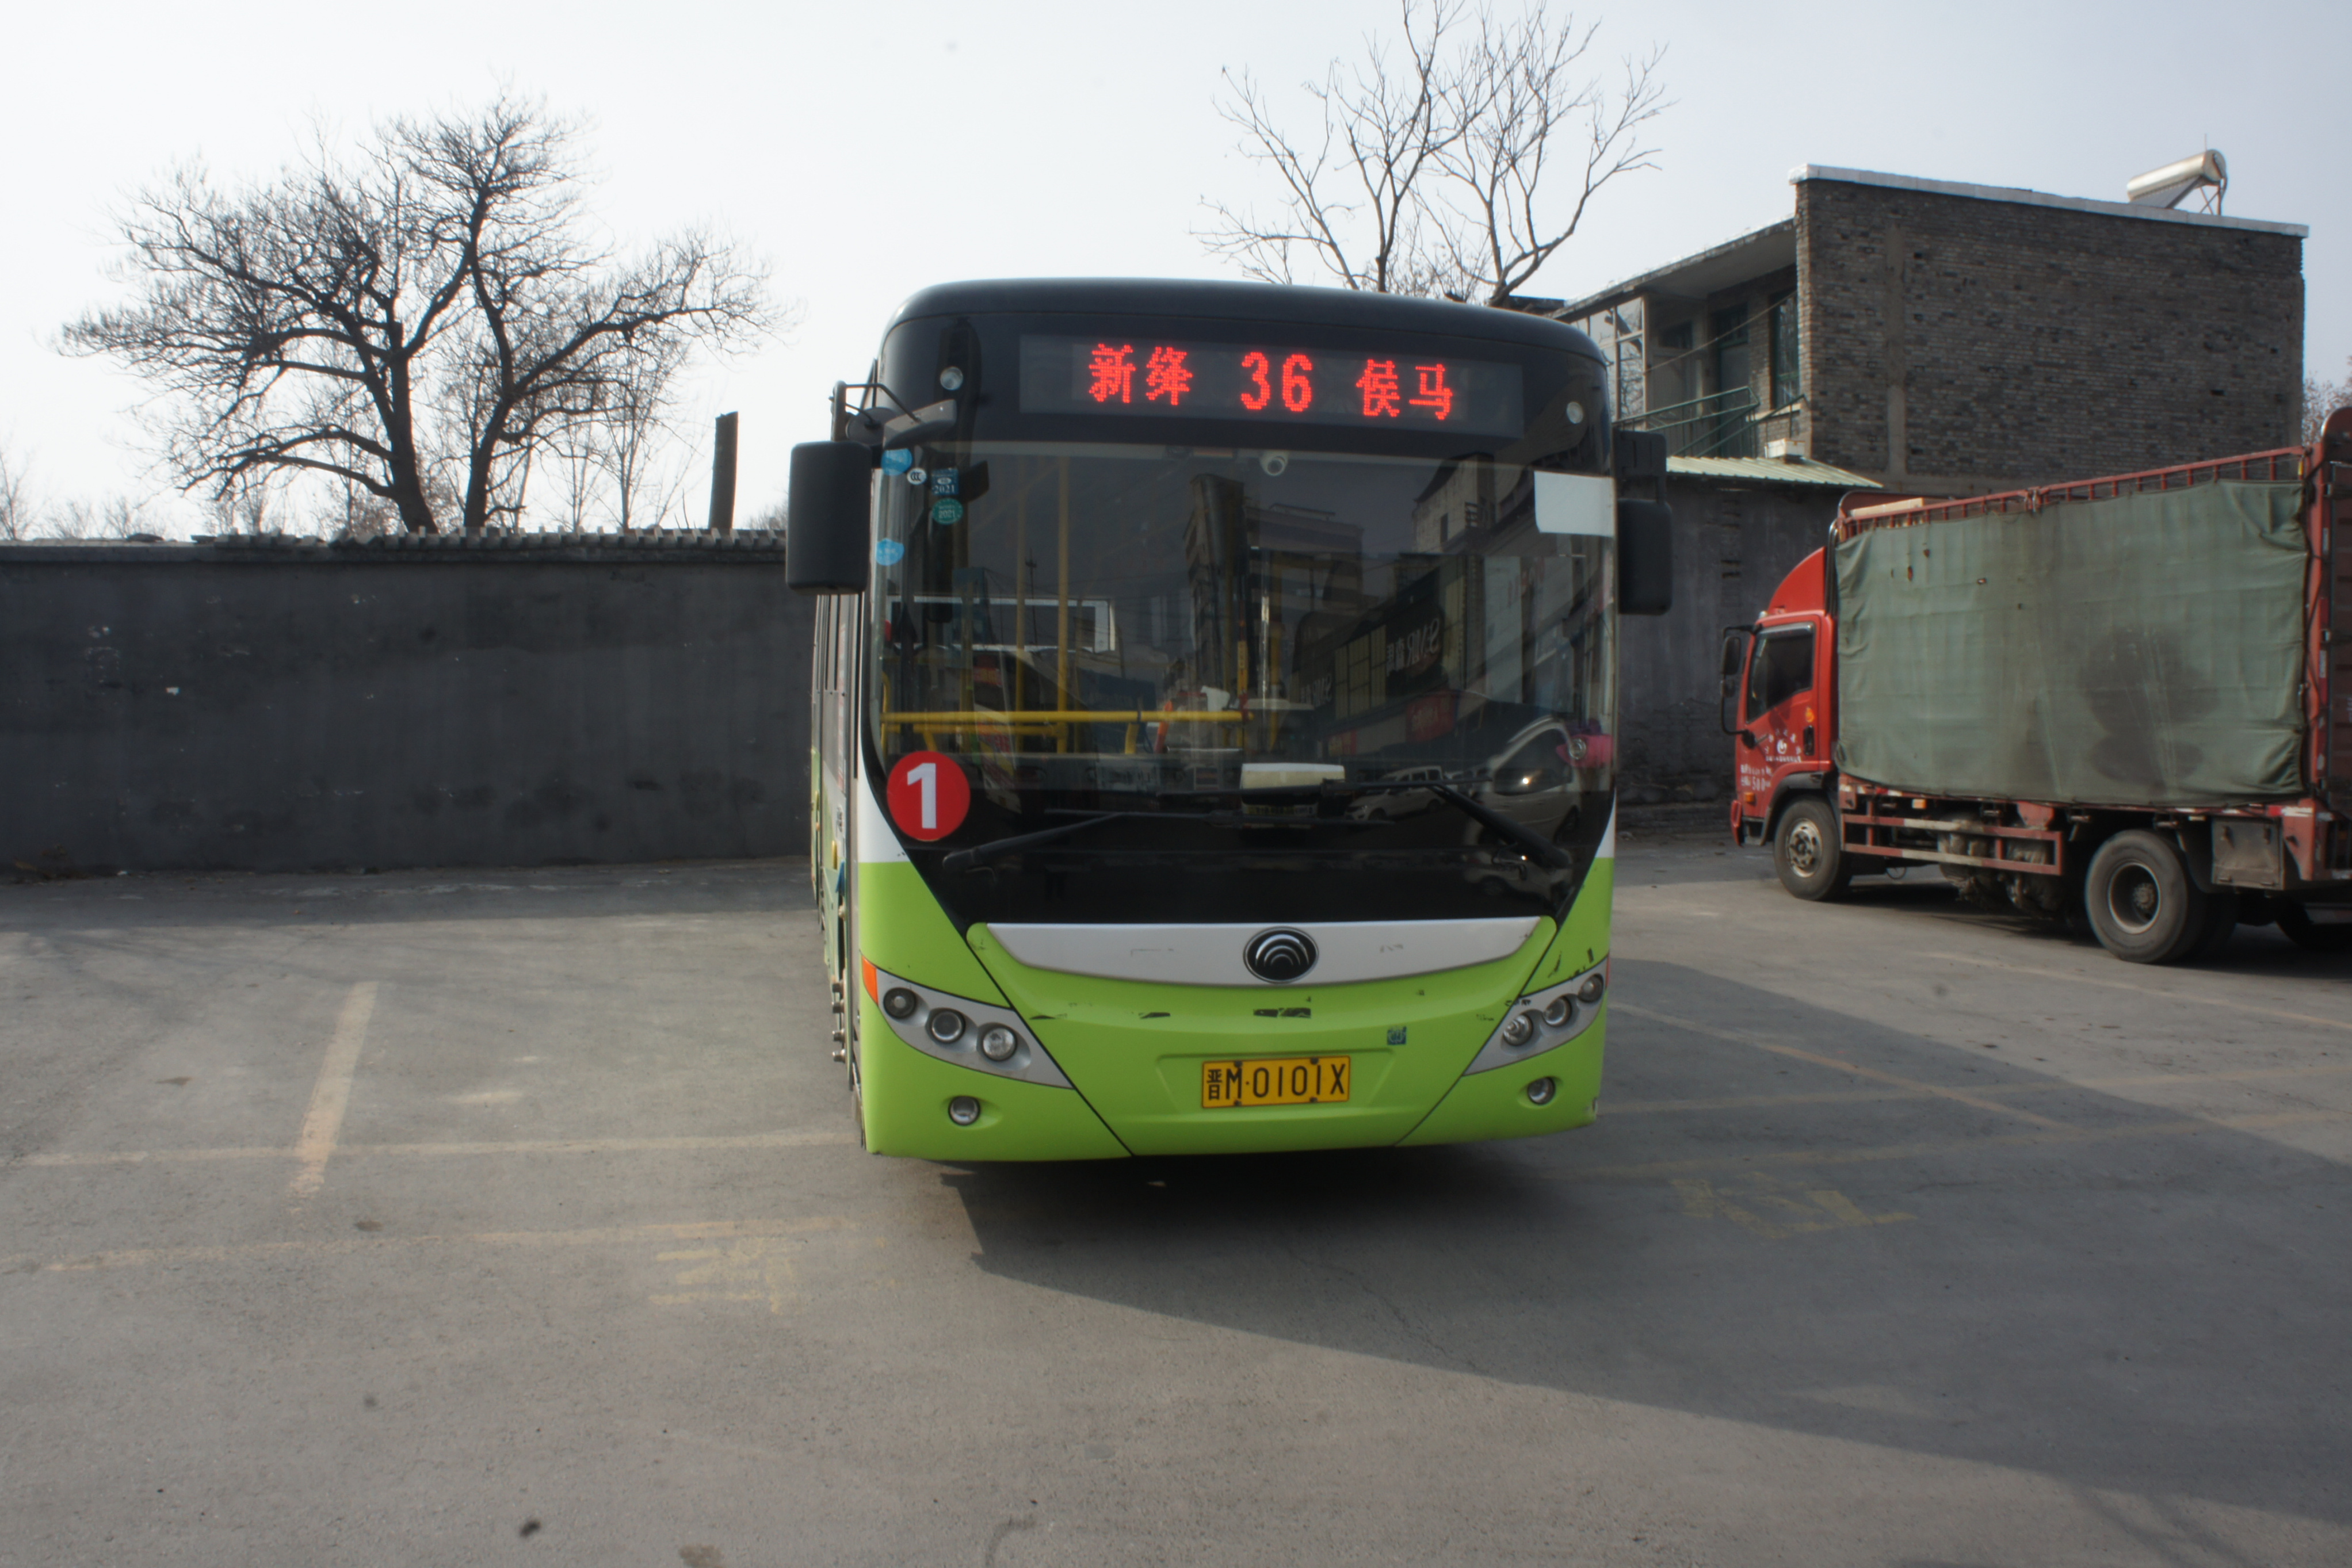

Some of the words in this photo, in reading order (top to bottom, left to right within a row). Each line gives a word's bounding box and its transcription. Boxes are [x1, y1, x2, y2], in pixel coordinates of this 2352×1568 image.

[1089, 343, 1194, 406] 新绛
[1240, 351, 1313, 412] 36
[1355, 359, 1453, 420] 侯马
[934, 484, 955, 495] 2021
[938, 510, 955, 519] 2021
[907, 762, 937, 830] 1
